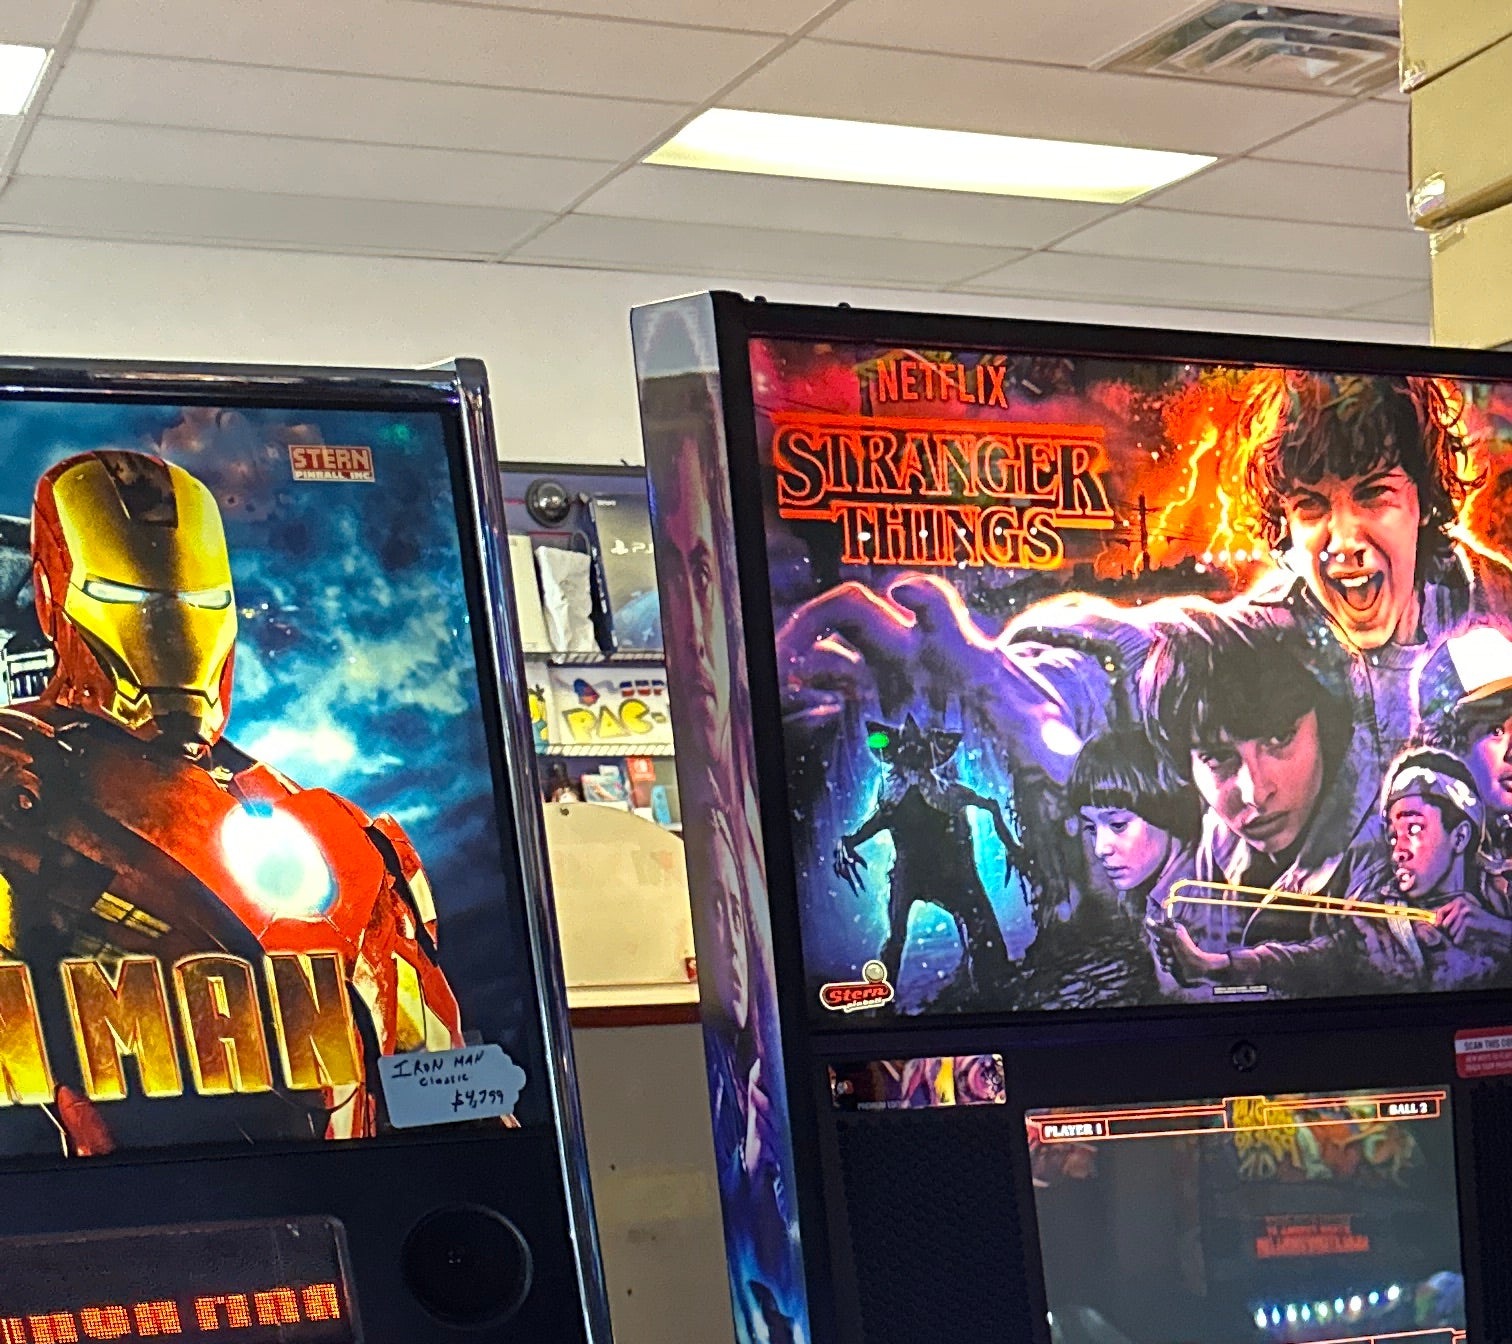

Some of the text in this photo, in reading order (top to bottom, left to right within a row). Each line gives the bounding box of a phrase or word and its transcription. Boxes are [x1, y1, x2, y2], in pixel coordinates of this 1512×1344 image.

[877, 357, 1008, 409] NETFLIX
[293, 448, 370, 470] STERN
[773, 425, 1114, 517] STRANGER
[842, 502, 1065, 569] THINGS
[829, 985, 888, 1004] Stern
[61, 952, 364, 1101] MAN
[392, 1050, 485, 1079] IRON MAN
[1389, 1103, 1415, 1116] BALL
[1044, 1123, 1103, 1138] PLAYER 1
